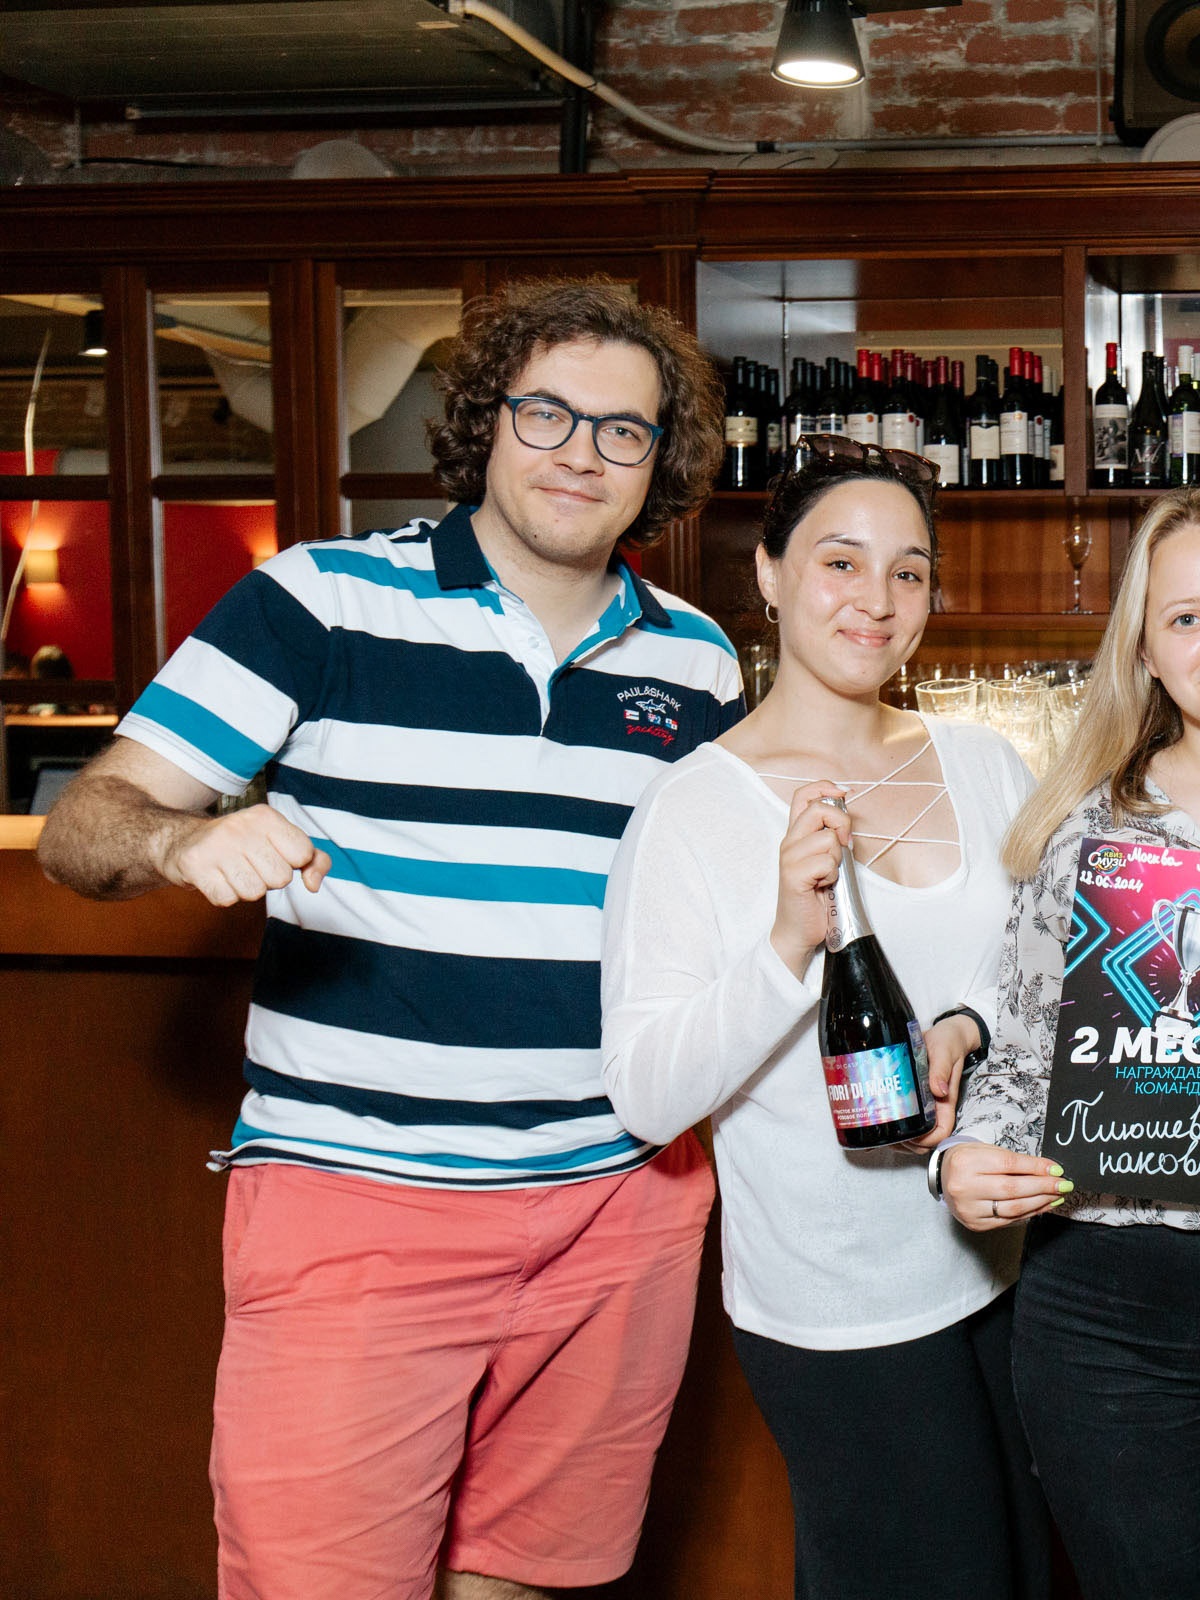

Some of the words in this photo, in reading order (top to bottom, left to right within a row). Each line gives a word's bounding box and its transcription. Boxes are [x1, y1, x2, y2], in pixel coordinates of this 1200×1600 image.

[616, 685, 682, 712] PAUL&SHARK
[1087, 851, 1127, 868] Смузи
[1103, 851, 1123, 859] КВИЗ
[1126, 846, 1183, 867] Москва
[1070, 1026, 1100, 1064] 2
[828, 1084, 850, 1101] FIORI
[851, 1082, 864, 1099] DI
[865, 1074, 902, 1097] MARE
